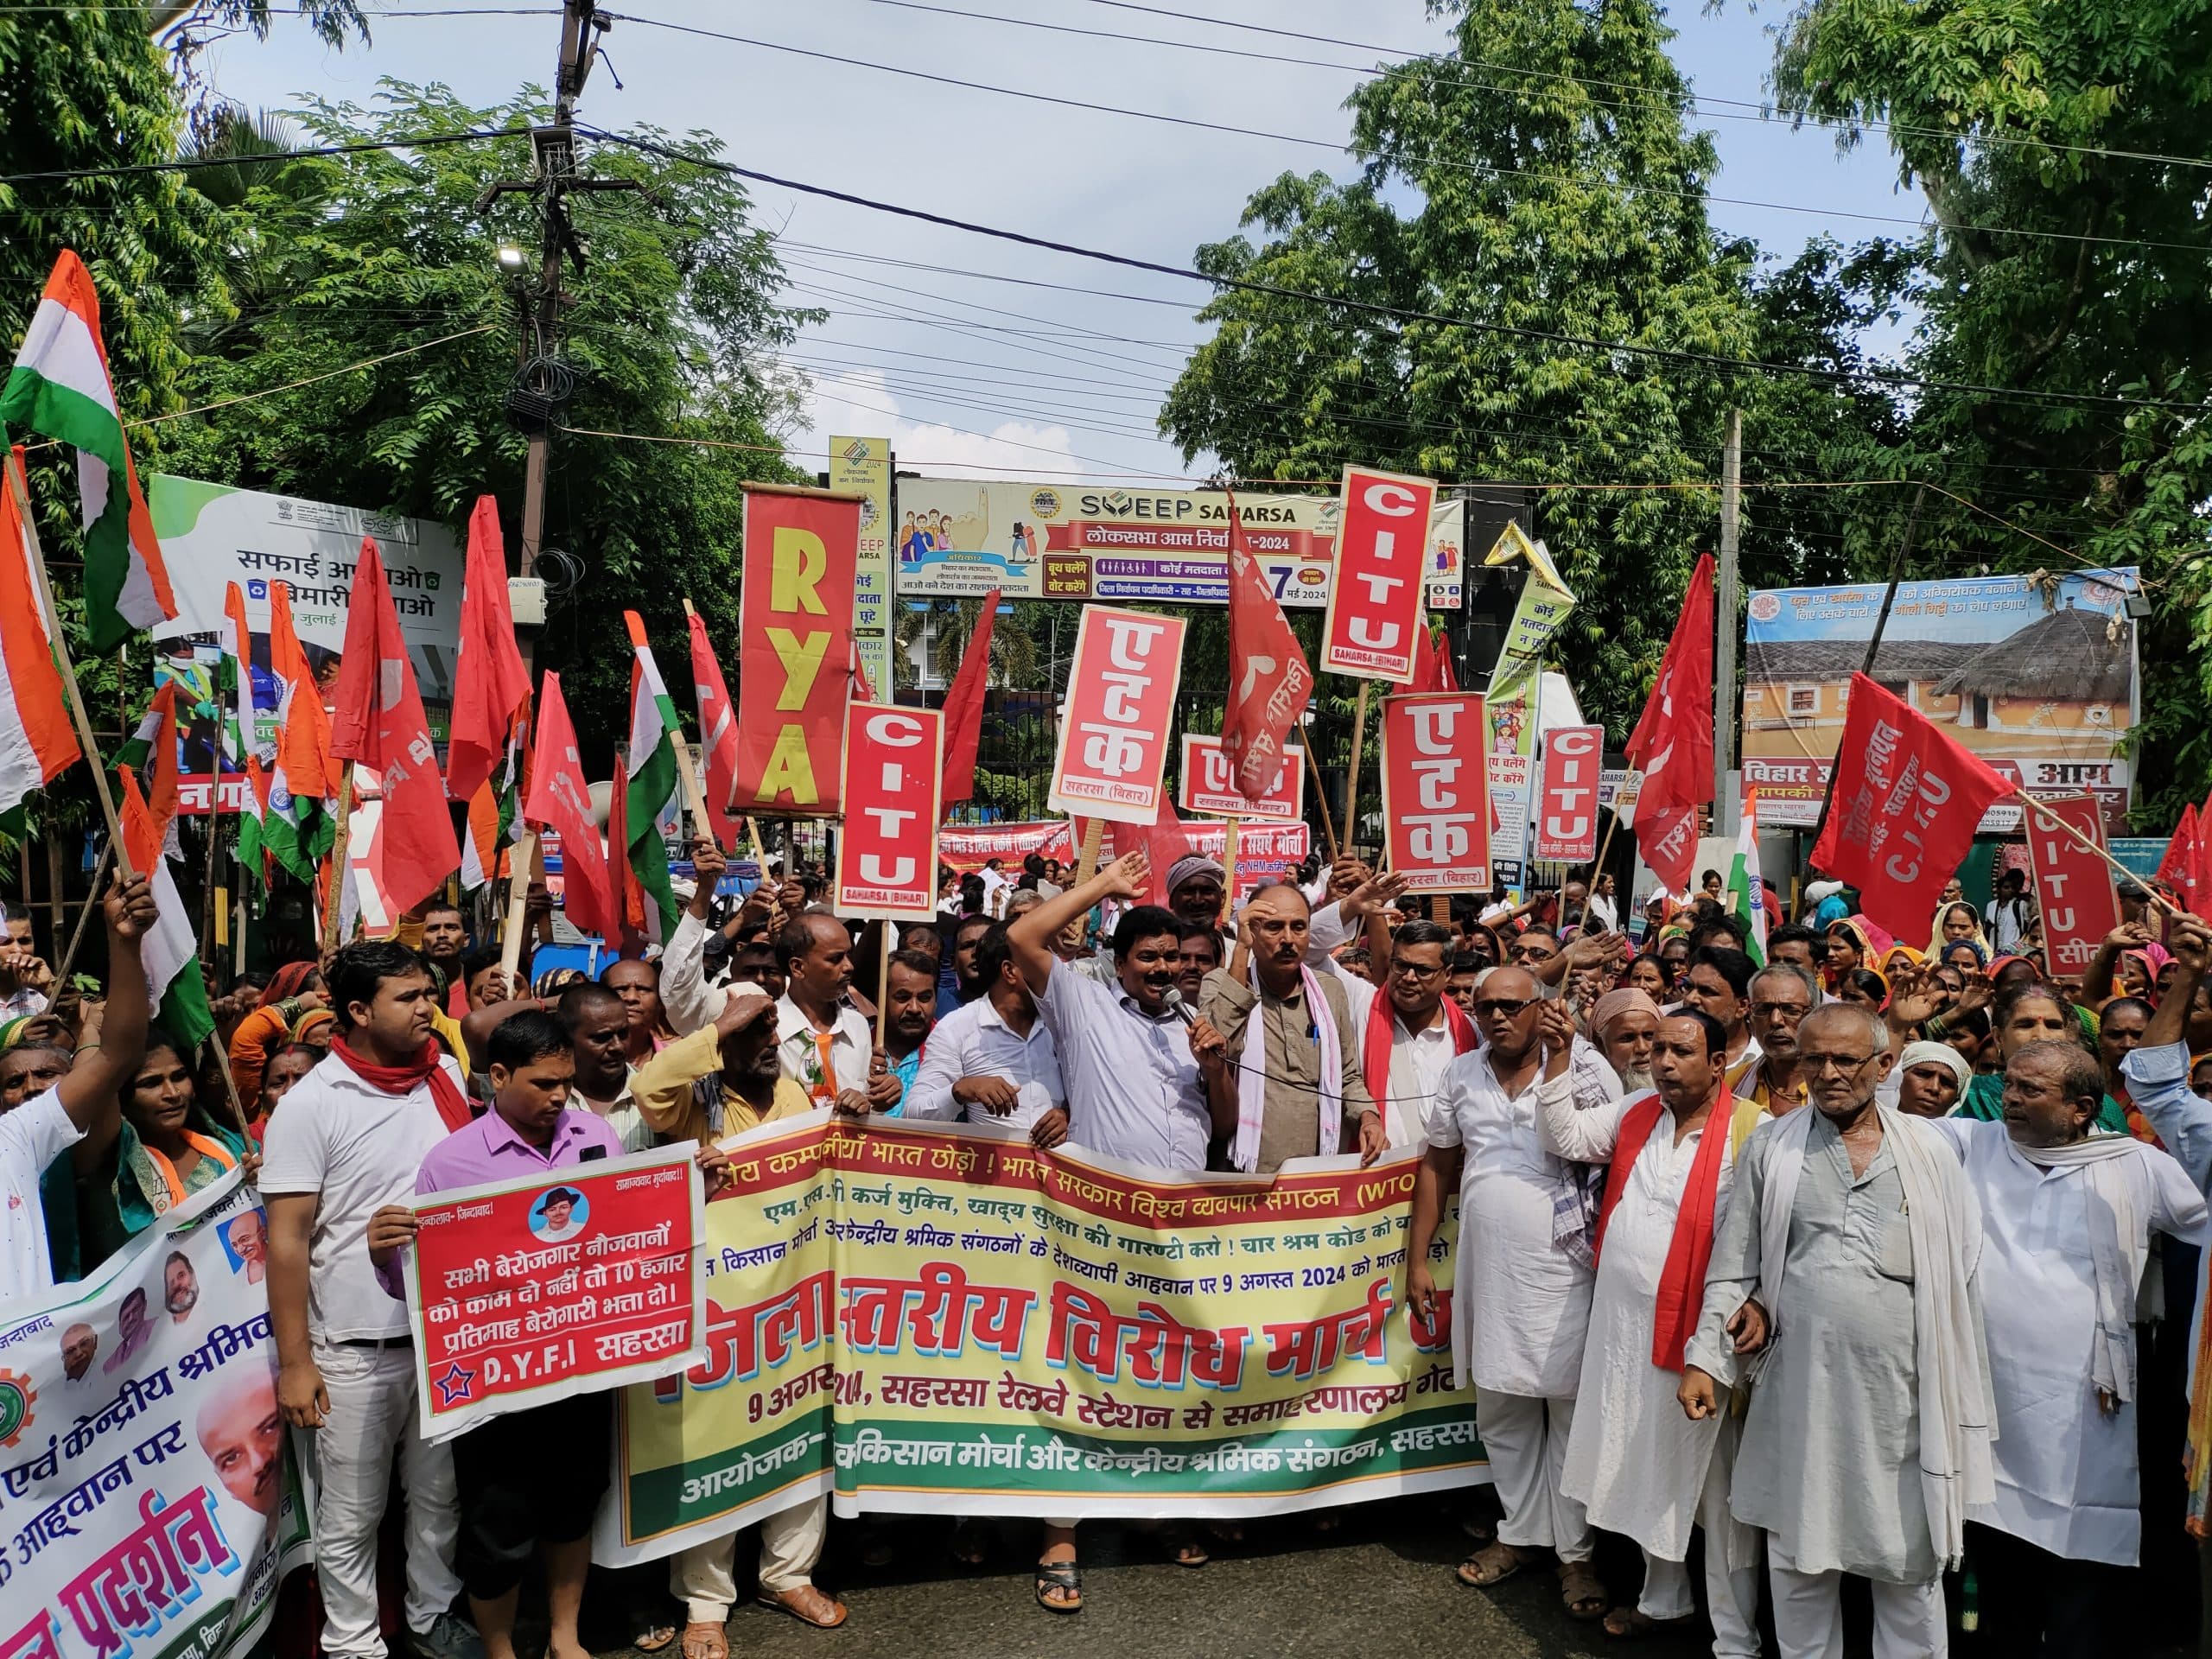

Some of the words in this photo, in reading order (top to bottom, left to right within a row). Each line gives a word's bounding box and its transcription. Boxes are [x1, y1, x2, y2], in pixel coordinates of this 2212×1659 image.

[1087, 525, 1156, 546] लोकसभा
[1161, 531, 1194, 546] आम
[1199, 505, 1295, 523] SAHARSA
[237, 549, 321, 579] सफाई
[859, 551, 880, 560] ARSA
[1048, 563, 1063, 575] बूथ
[1065, 561, 1086, 575] चलेंगे
[1160, 561, 1181, 575] कोई
[1185, 563, 1221, 575] मतदाता
[1348, 484, 1416, 649] CITU
[1048, 580, 1062, 592] वोट
[1065, 580, 1086, 593] करेंगे
[1268, 566, 1293, 600] 7
[1302, 590, 1326, 600] 2024
[1334, 649, 1373, 664] SAHARSA
[1079, 619, 1164, 777] एटक
[1065, 779, 1104, 797] सहरसा
[1109, 783, 1149, 805] (बिहार)
[1400, 703, 1476, 864] एटक
[1546, 732, 1593, 839] CITU
[1742, 760, 1811, 783] बिहार
[860, 714, 924, 885] CITU
[1198, 796, 1241, 810] सहरसा
[1247, 861, 1266, 872] NHM
[1407, 874, 1438, 885] हरसा
[1442, 869, 1482, 885] (बिहार)
[845, 887, 888, 904] SAHARSA
[891, 891, 925, 907] (BIHAR)
[871, 1141, 926, 1167] भारत
[930, 1143, 979, 1176] छोड़ो
[1001, 1155, 1052, 1185] भारत
[1056, 1168, 1126, 1211] सरकार
[1130, 1191, 1187, 1218] विश्व
[1264, 1186, 1341, 1211] संगठन
[851, 1184, 892, 1205] कर्ज
[1032, 1205, 1079, 1237] सुरक्षा
[1084, 1224, 1111, 1249] की
[1117, 1235, 1184, 1260] गारण्टी
[1189, 1235, 1221, 1258] करो
[1241, 1236, 1276, 1255] चार
[1282, 1233, 1319, 1251] श्रम
[1326, 1224, 1367, 1248] कोड
[1371, 1216, 1392, 1237] को
[444, 1258, 490, 1290] सभी
[495, 1242, 582, 1280] बेरोजगार
[586, 1221, 672, 1257] नौजवानों
[721, 1241, 787, 1273] किसान
[791, 1217, 818, 1251] मोर्चा
[905, 1224, 955, 1248] श्रमिक
[961, 1228, 1025, 1255] संगठनों
[1029, 1236, 1049, 1258] के
[1052, 1243, 1118, 1284] देशव्यापी
[1199, 1278, 1217, 1294] पर
[1223, 1274, 1233, 1293] 9
[1240, 1271, 1294, 1291] अगस्त
[1301, 1266, 1345, 1287] 2024
[1351, 1255, 1371, 1278] को
[1376, 1247, 1408, 1271] भारत
[428, 1300, 459, 1324] को
[465, 1288, 512, 1316] काम
[518, 1280, 540, 1303] दो
[545, 1265, 579, 1296] नहीं
[583, 1262, 608, 1287] तो
[615, 1262, 633, 1282] 10
[639, 1253, 686, 1280] हजार
[442, 1318, 520, 1356] प्रतिमाह
[525, 1299, 596, 1333] बेरोगारी
[602, 1291, 644, 1316] भत्ता
[595, 1319, 688, 1362] सहरसा
[1045, 1280, 1253, 1391] विरोध
[1263, 1277, 1394, 1383] मार्च
[748, 1392, 763, 1423] 9
[880, 1375, 990, 1408] सहरसा
[997, 1370, 1070, 1417] रेलवे
[1077, 1390, 1175, 1430] स्टेशन
[1183, 1400, 1213, 1430] से
[1222, 1382, 1412, 1427] समाहरणालय
[8, 1431, 60, 1497] एवं
[62, 1365, 174, 1461] केन्द्रीय
[132, 1420, 187, 1469] पर
[855, 1428, 956, 1466] किसान
[957, 1433, 1026, 1469] मोर्चा
[1027, 1435, 1080, 1472] और
[1084, 1439, 1187, 1478] केन्द्रीय
[1188, 1443, 1282, 1472] श्रमिक
